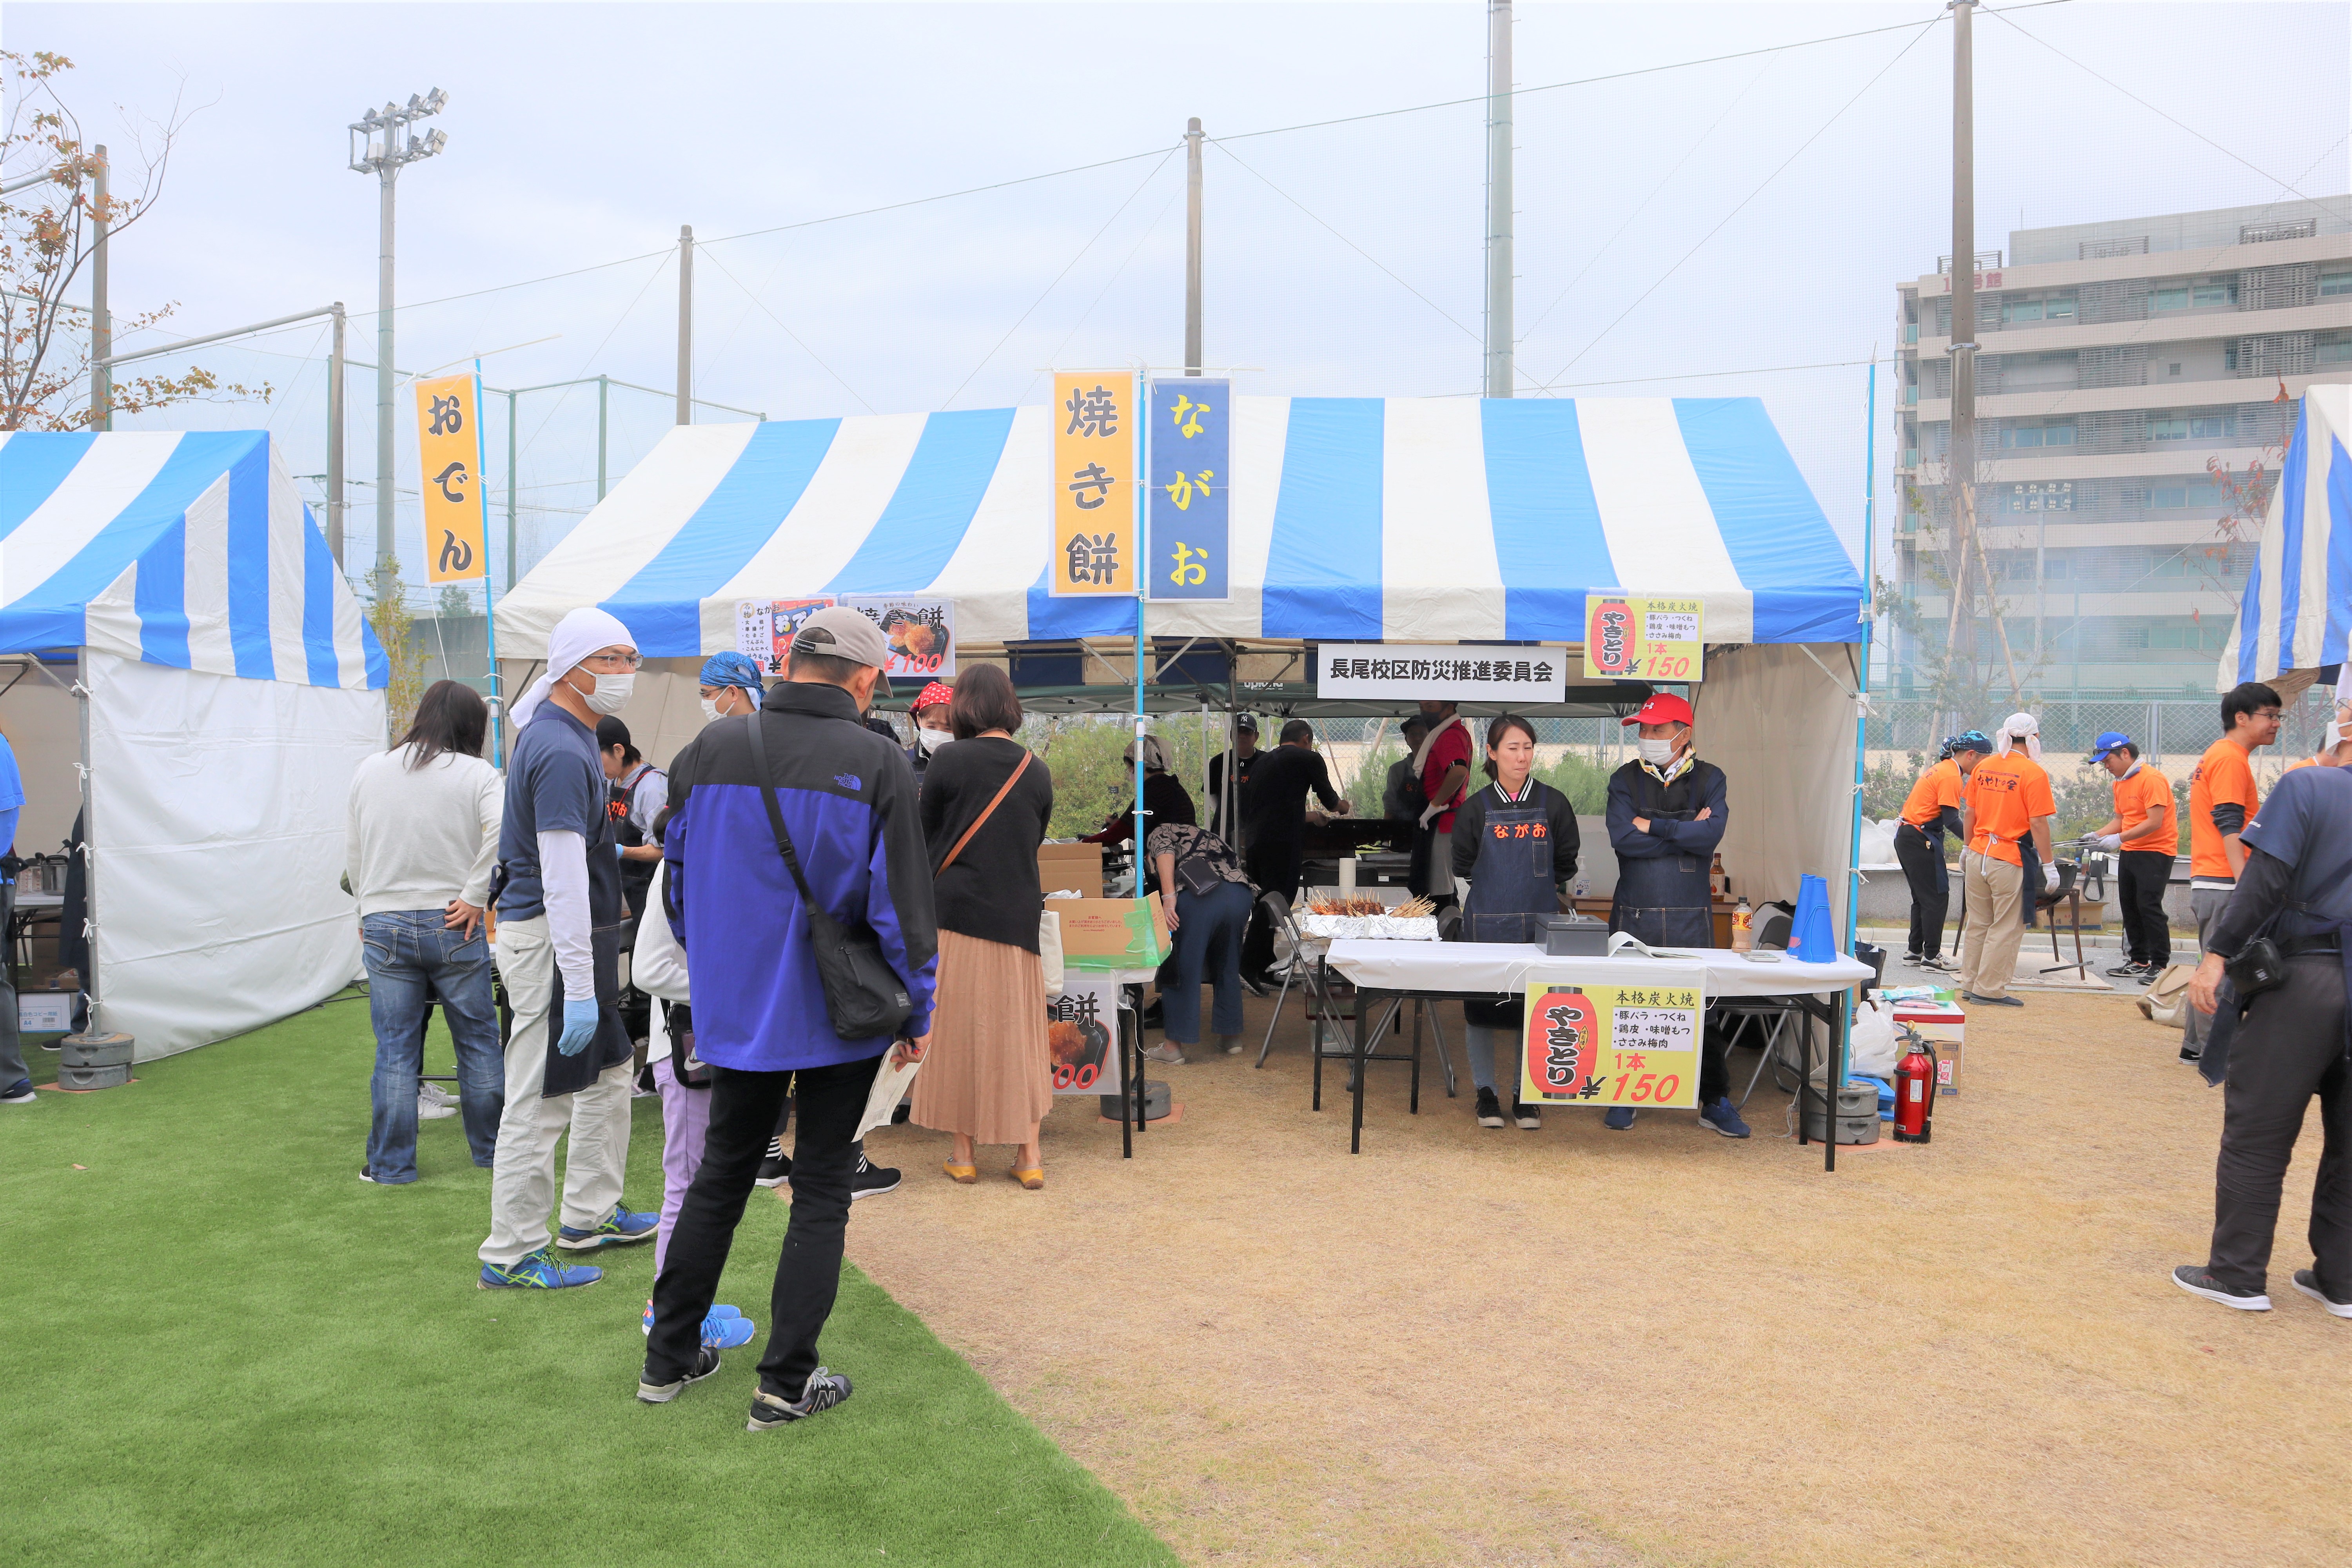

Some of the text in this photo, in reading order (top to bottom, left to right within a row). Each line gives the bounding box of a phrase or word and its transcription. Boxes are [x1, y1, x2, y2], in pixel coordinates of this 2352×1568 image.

[1944, 272, 2002, 292] 1号館
[427, 394, 472, 573] おでん
[1065, 385, 1118, 585] 焼き餅
[1165, 394, 1214, 586] ながお
[757, 604, 780, 615] ながお
[1646, 601, 1698, 612] 本格炭火焼
[775, 608, 818, 633] おで
[1602, 612, 1626, 666] やきとり
[1647, 642, 1668, 655] 1本
[1330, 658, 1553, 682] 長尾校区防災推進委員会
[1646, 657, 1690, 677] 150
[834, 775, 853, 784] NORTH
[1977, 774, 2017, 791] おやじの会
[1494, 823, 1547, 838] ながお
[1054, 991, 1100, 1027] 餅
[1616, 990, 1694, 1007] 本格炭火焼
[1546, 1006, 1583, 1085] やきとり
[1615, 1053, 1646, 1071] 1本
[1053, 1063, 1098, 1090] 00
[1612, 1073, 1679, 1102] 150
